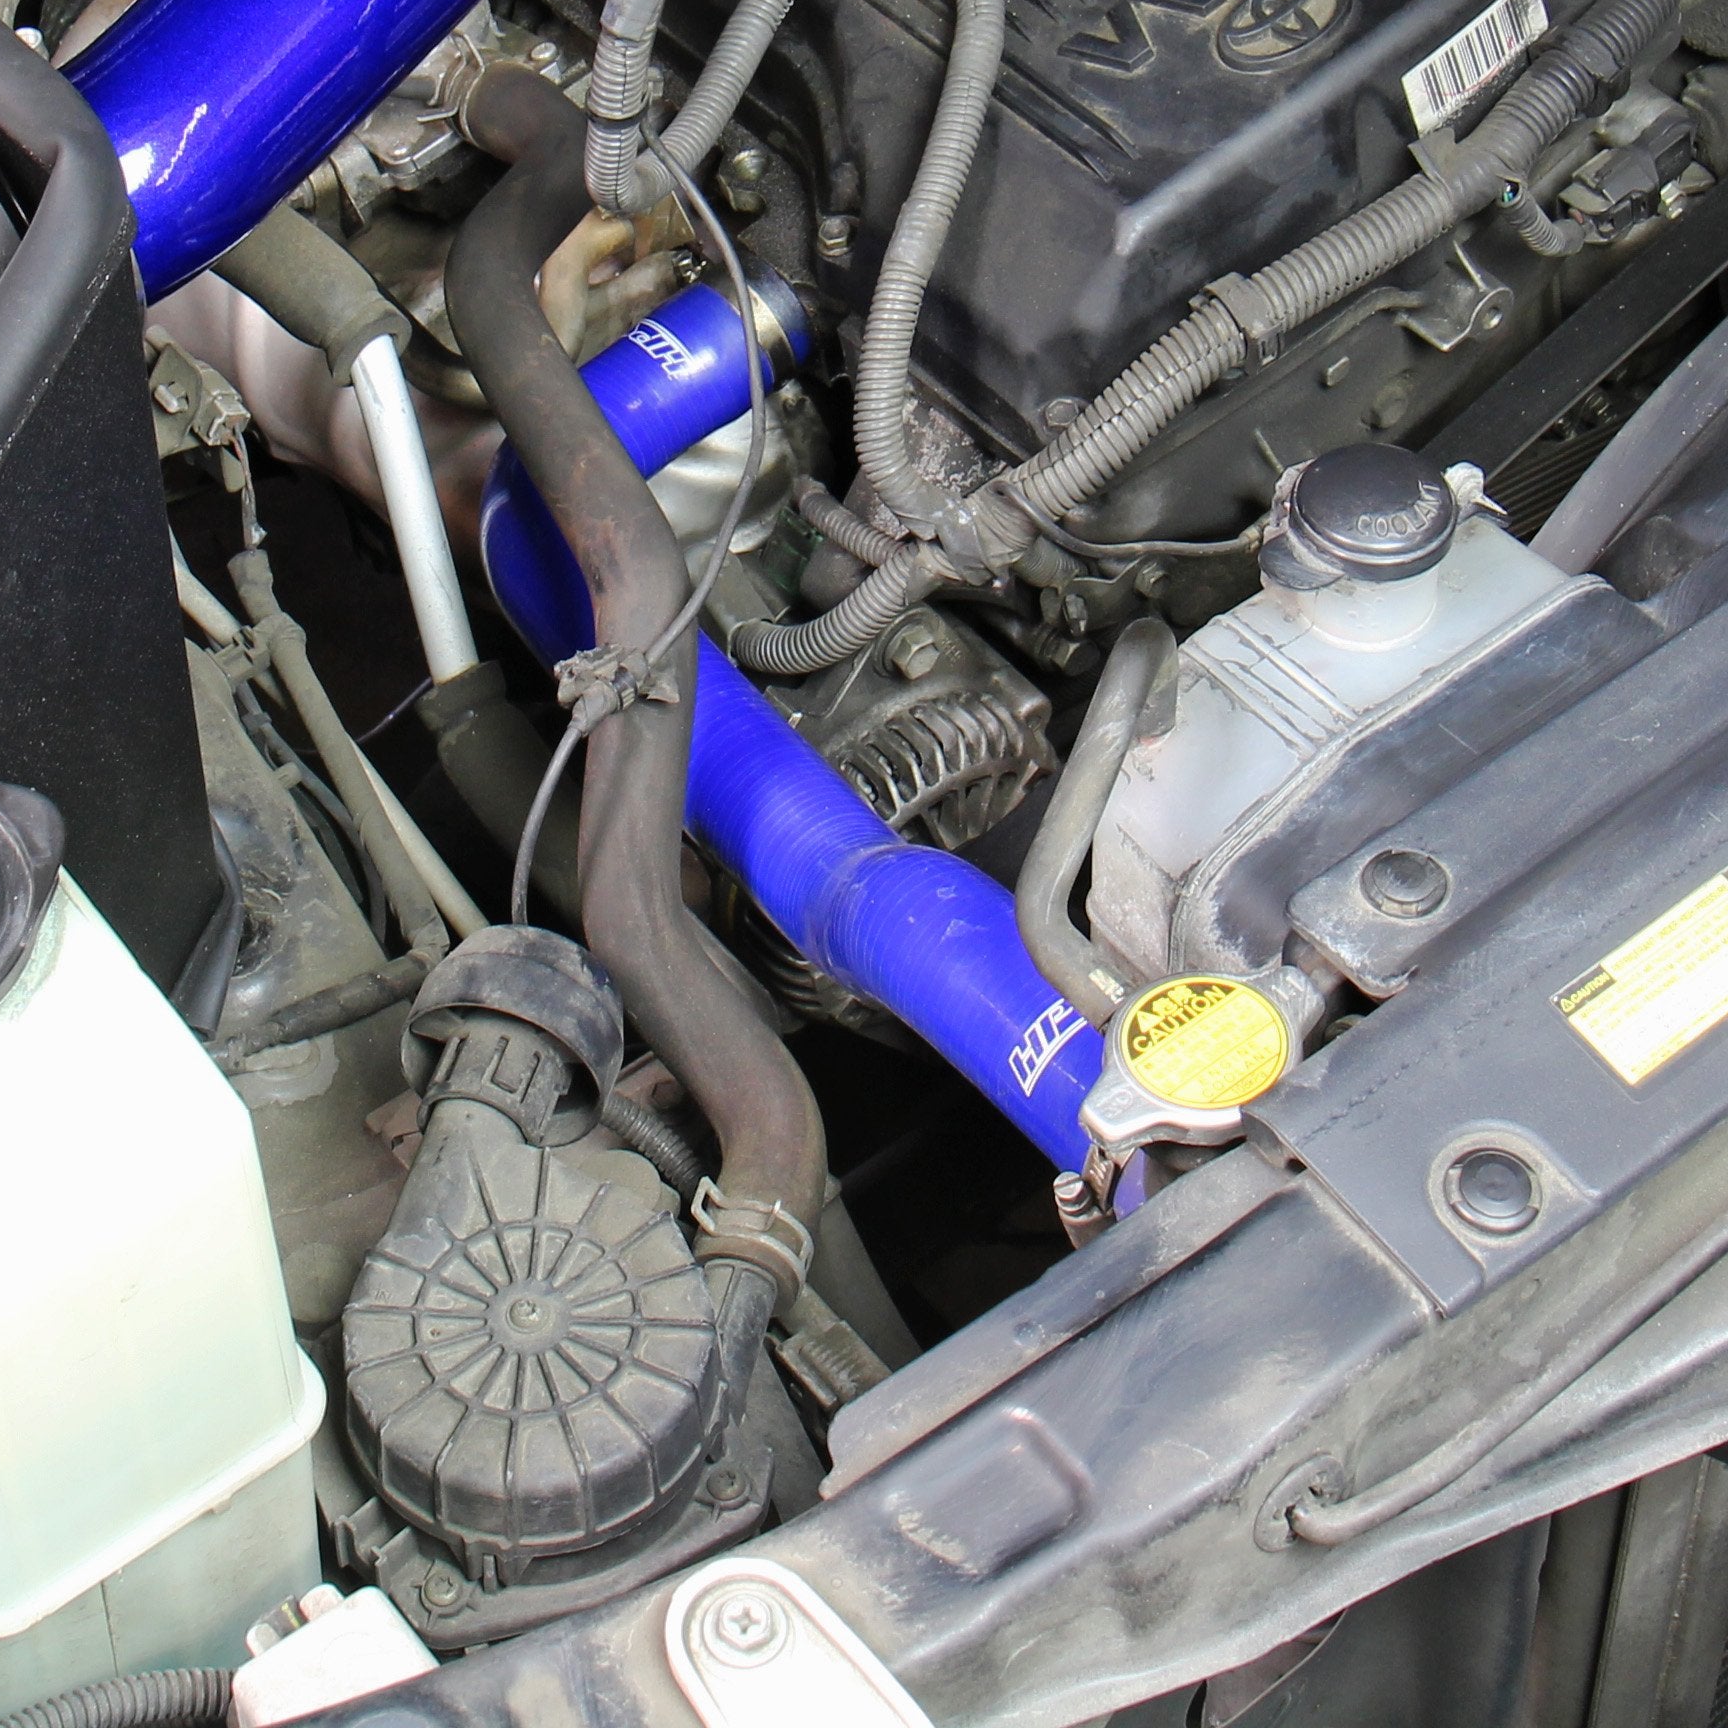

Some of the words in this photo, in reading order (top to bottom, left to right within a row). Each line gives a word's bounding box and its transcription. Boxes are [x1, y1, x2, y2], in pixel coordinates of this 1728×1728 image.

[1357, 480, 1441, 538] COOLANT
[1571, 971, 1611, 1004] CAUTION
[1133, 985, 1226, 1054] CAUTION
